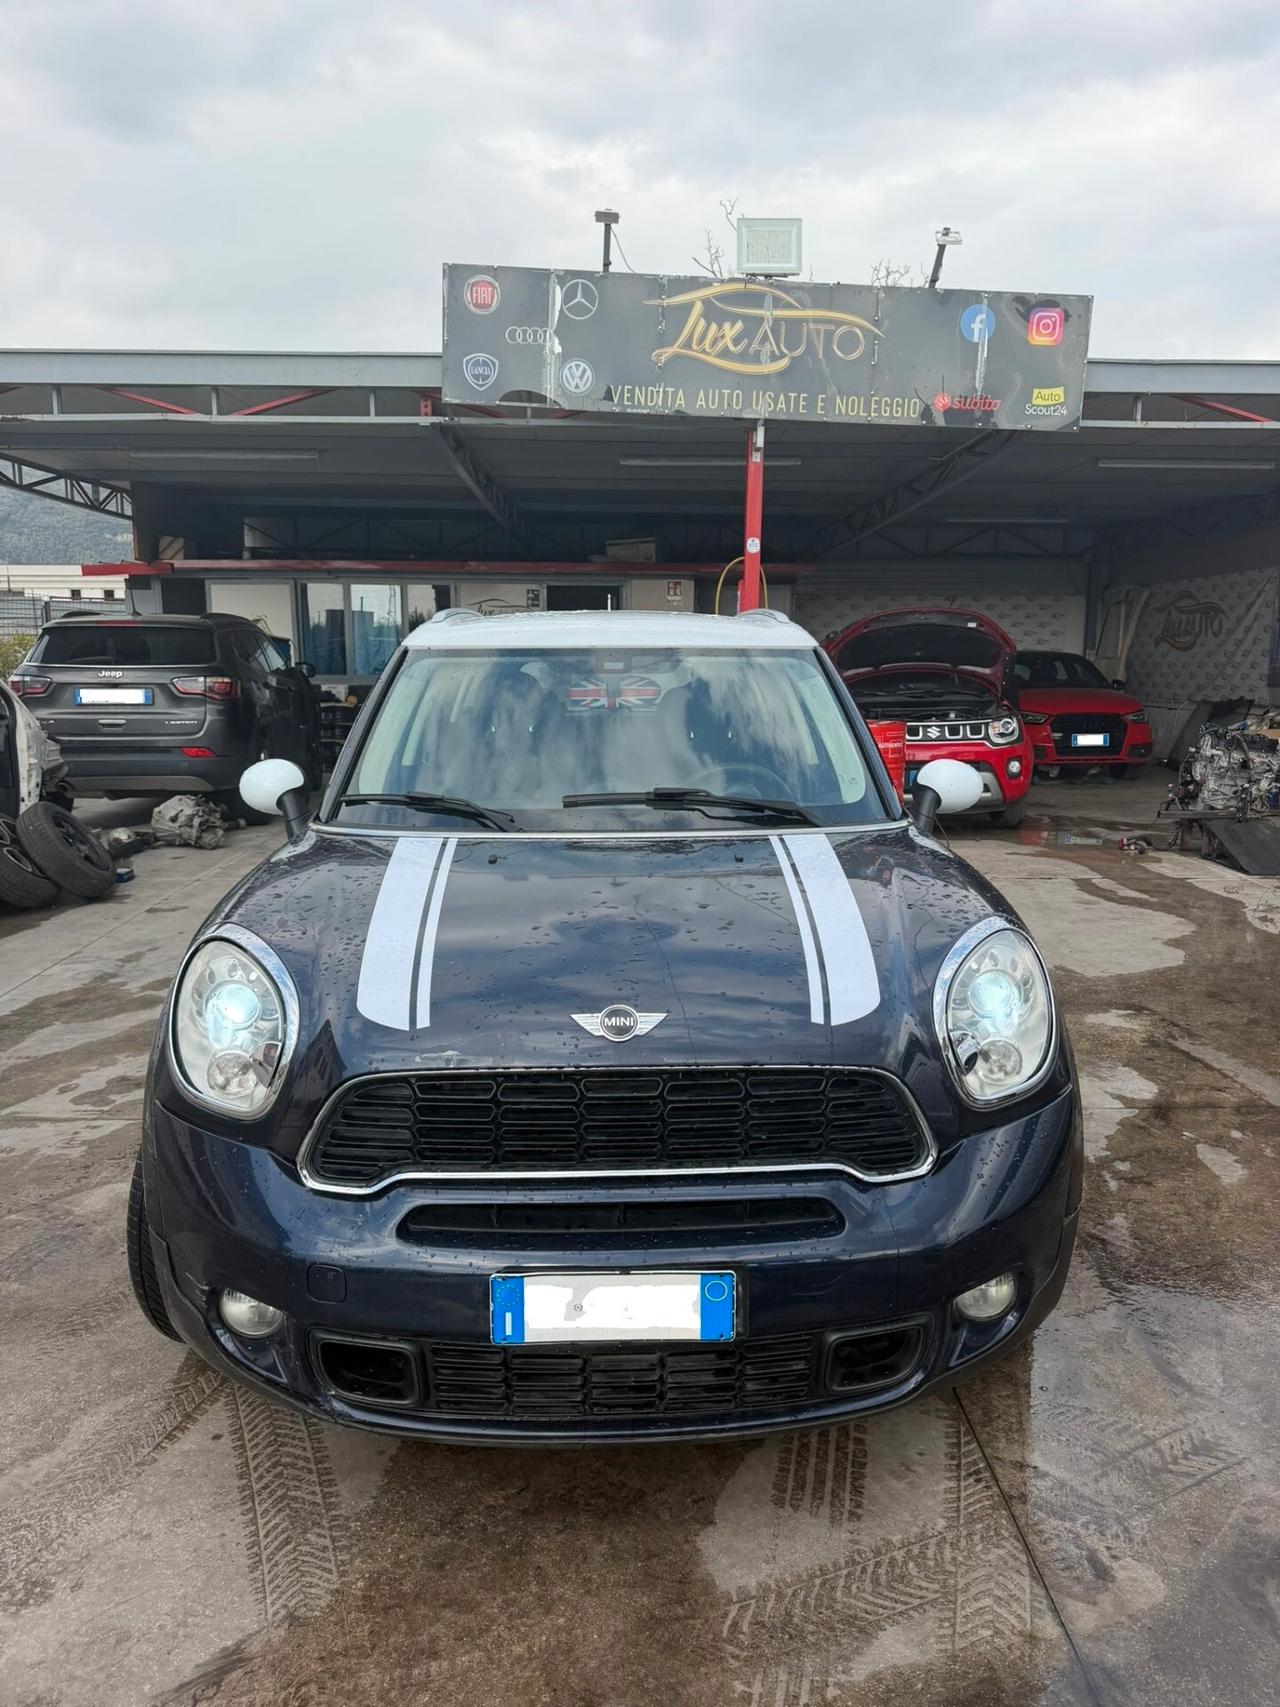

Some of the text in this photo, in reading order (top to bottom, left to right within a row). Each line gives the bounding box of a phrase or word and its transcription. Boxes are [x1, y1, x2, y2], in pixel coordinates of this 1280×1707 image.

[472, 286, 493, 305] FIAT
[610, 383, 920, 418] VENDITA AUTO USATE E NOLEGGIO
[1034, 391, 1061, 403] Auto
[1025, 403, 1068, 416] Scout24
[98, 670, 123, 678] Jeep
[604, 1016, 634, 1027] MINI
